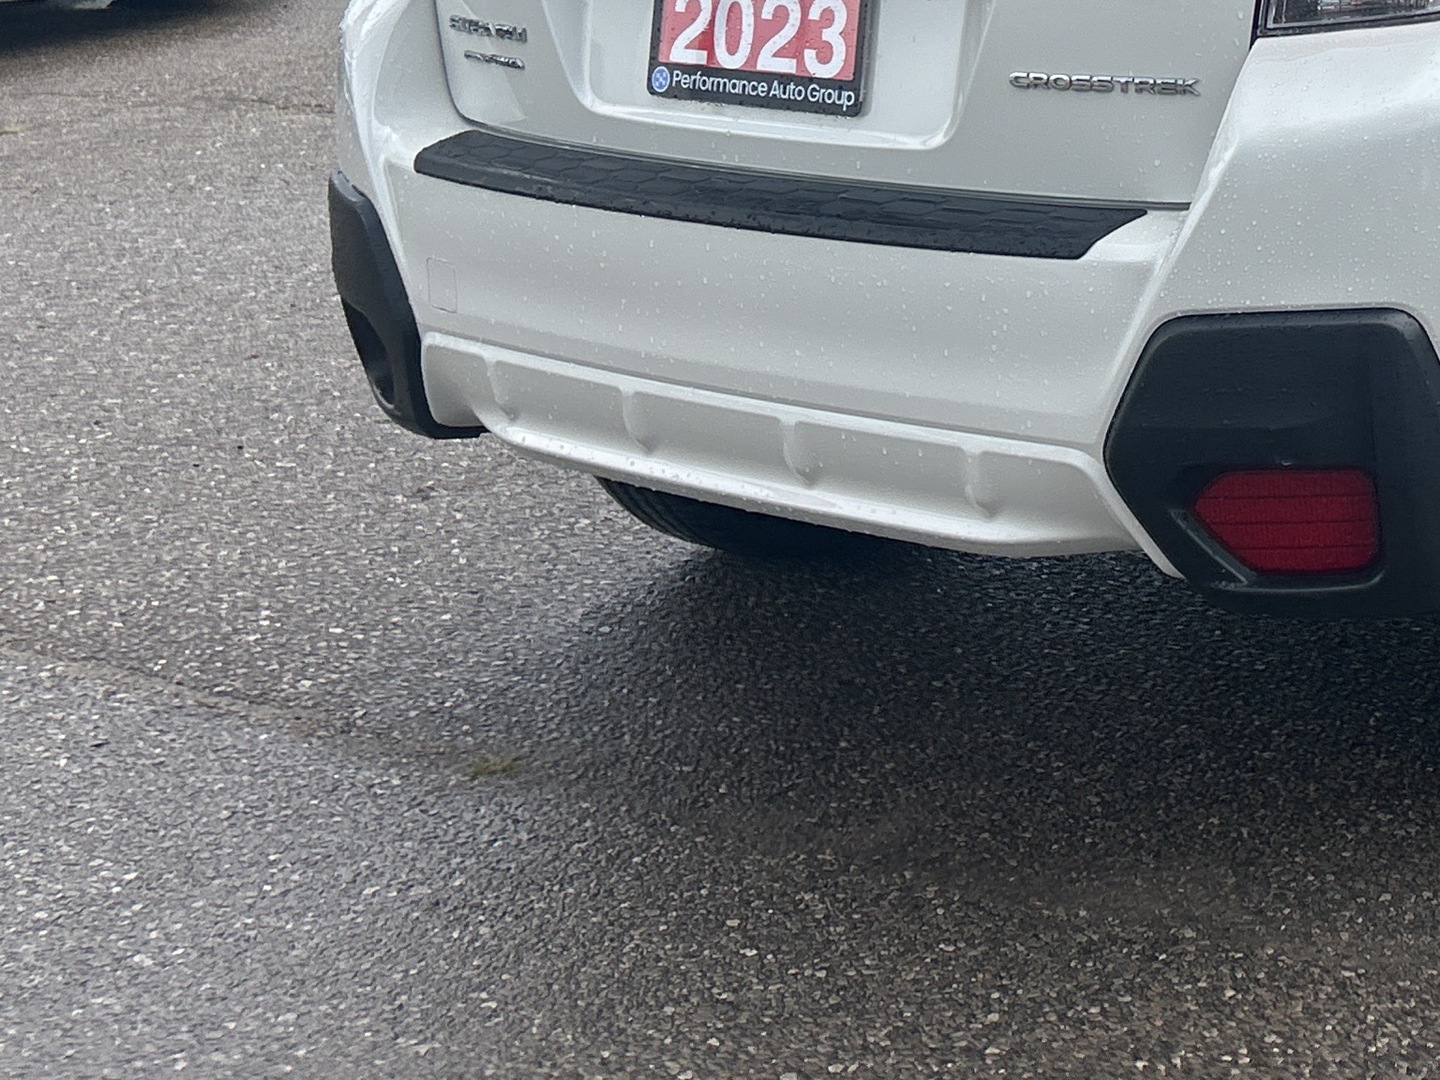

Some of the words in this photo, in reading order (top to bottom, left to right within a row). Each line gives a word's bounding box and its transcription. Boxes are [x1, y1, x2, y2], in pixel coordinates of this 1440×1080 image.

[672, 70, 767, 97] Performance
[769, 80, 804, 101] Auto
[807, 83, 856, 111] Group
[1008, 71, 1202, 97] CROSSTREK
